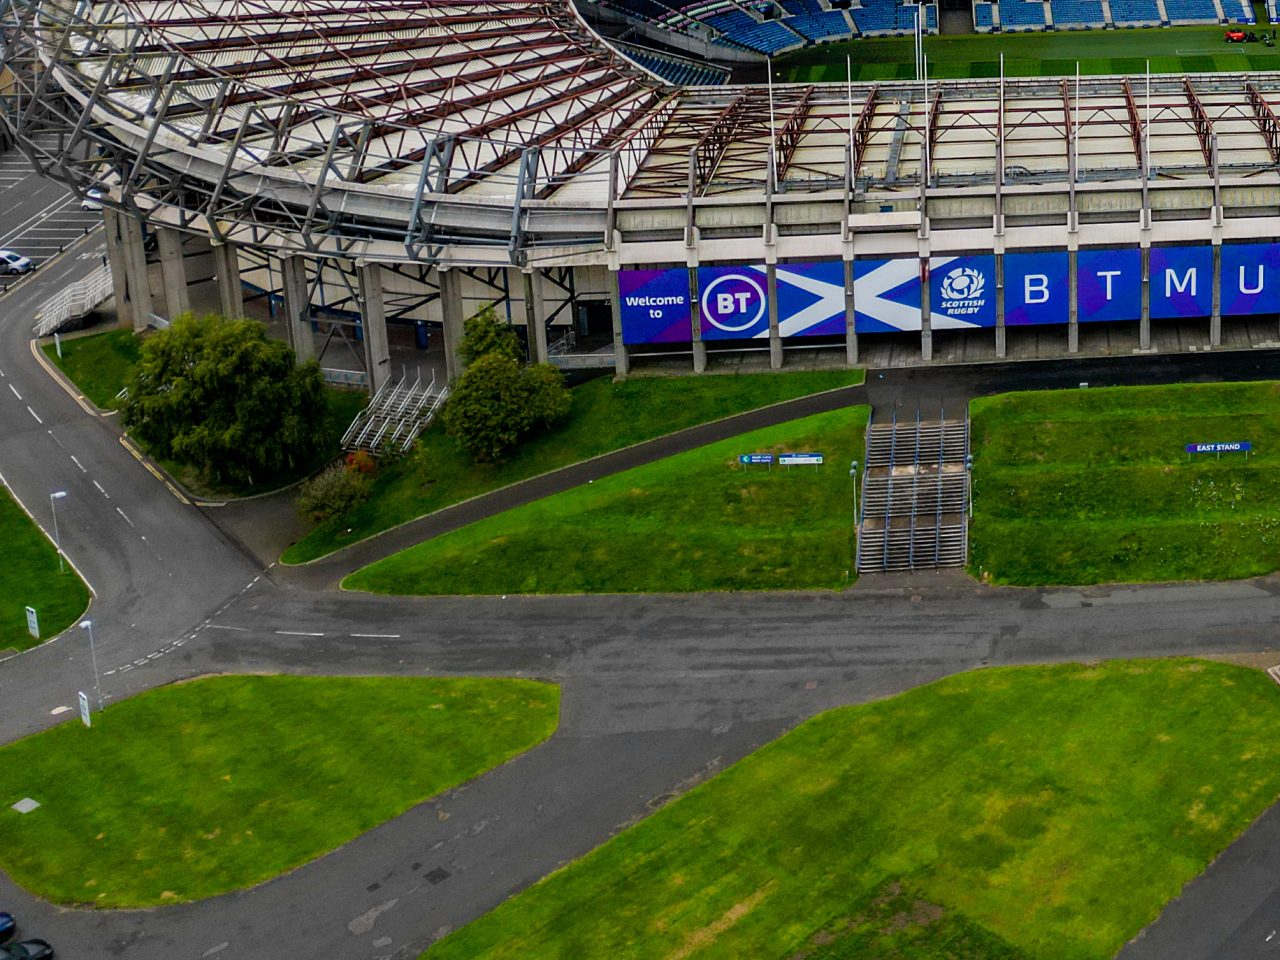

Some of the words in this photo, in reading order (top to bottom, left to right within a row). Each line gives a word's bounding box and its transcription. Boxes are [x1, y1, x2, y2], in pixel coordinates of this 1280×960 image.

[626, 296, 684, 306] Welcome
[717, 292, 751, 314] BT
[941, 300, 985, 308] SCOTTISH
[649, 309, 663, 318] to
[947, 307, 980, 315] RUGBY
